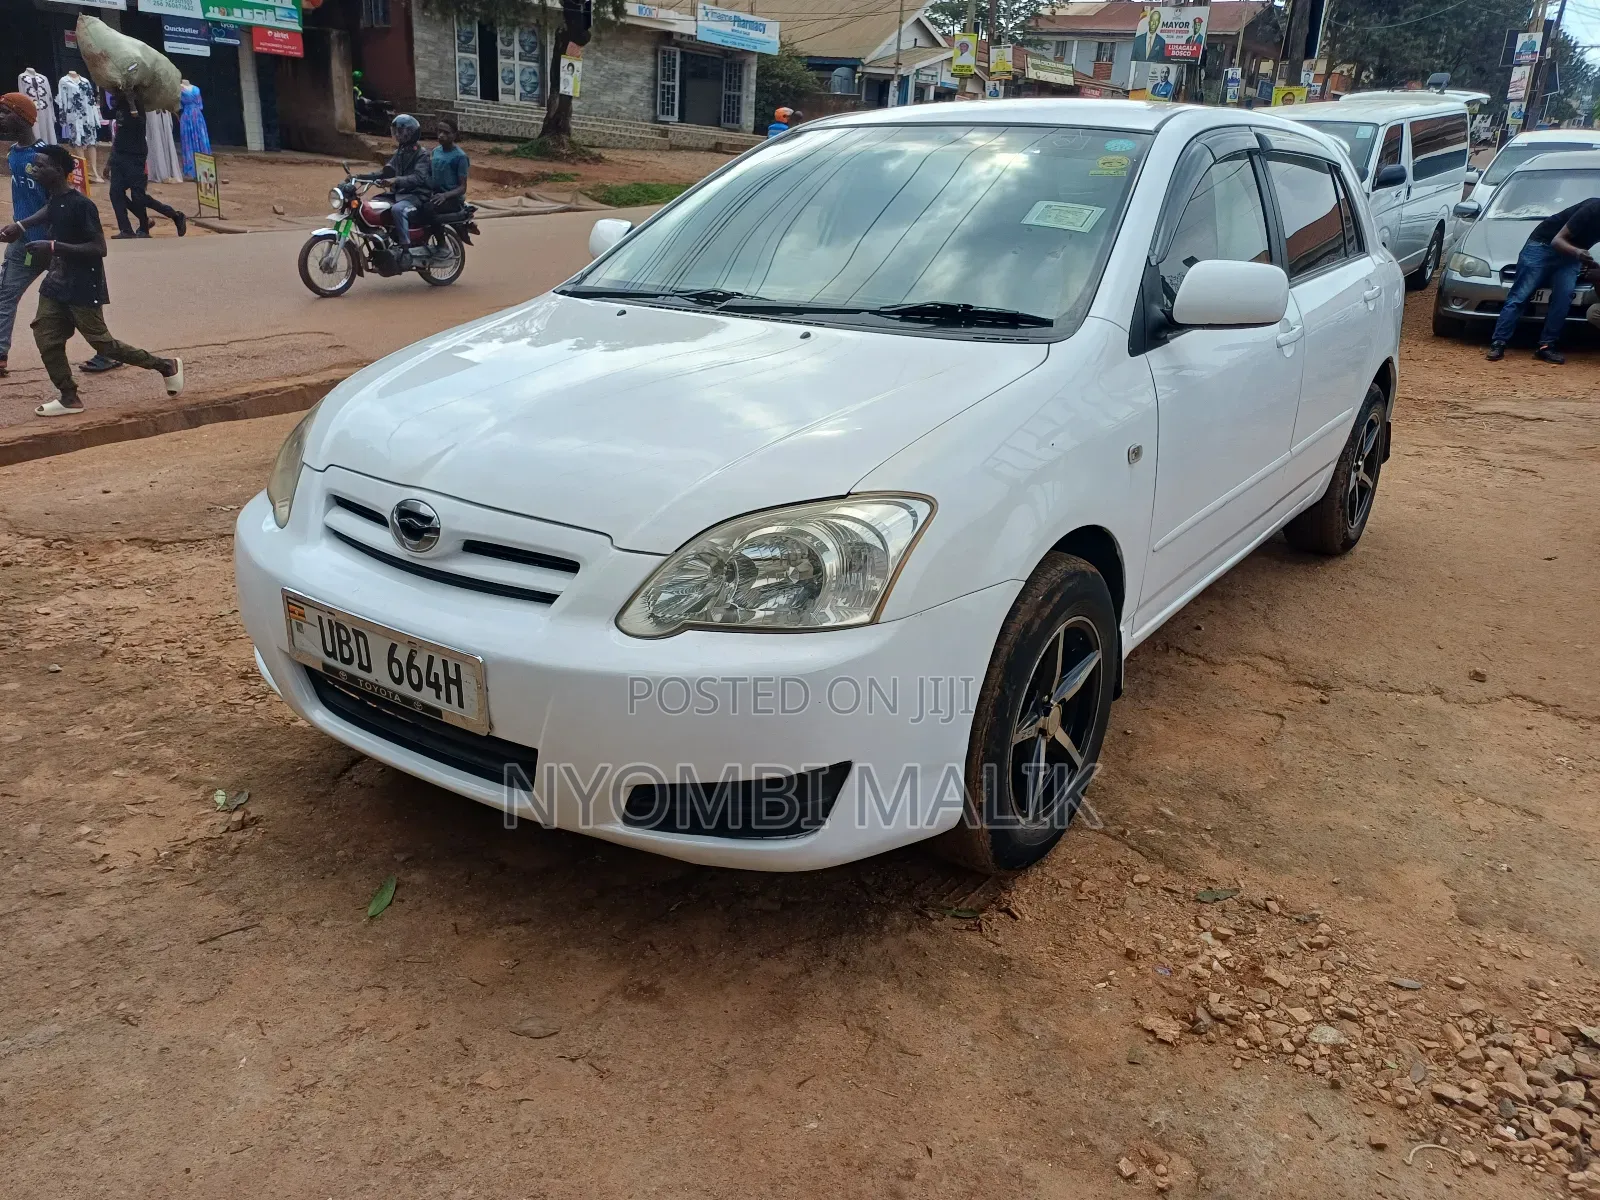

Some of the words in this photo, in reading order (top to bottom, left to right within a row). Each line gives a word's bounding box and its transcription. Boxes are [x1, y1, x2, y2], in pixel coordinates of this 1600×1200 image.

[164, 25, 199, 34] Quickteller
[733, 15, 766, 34] Pharmacy
[273, 31, 289, 39] airtel
[318, 615, 372, 674] UBD
[387, 643, 464, 709] 664H
[358, 679, 401, 702] TOYOTA
